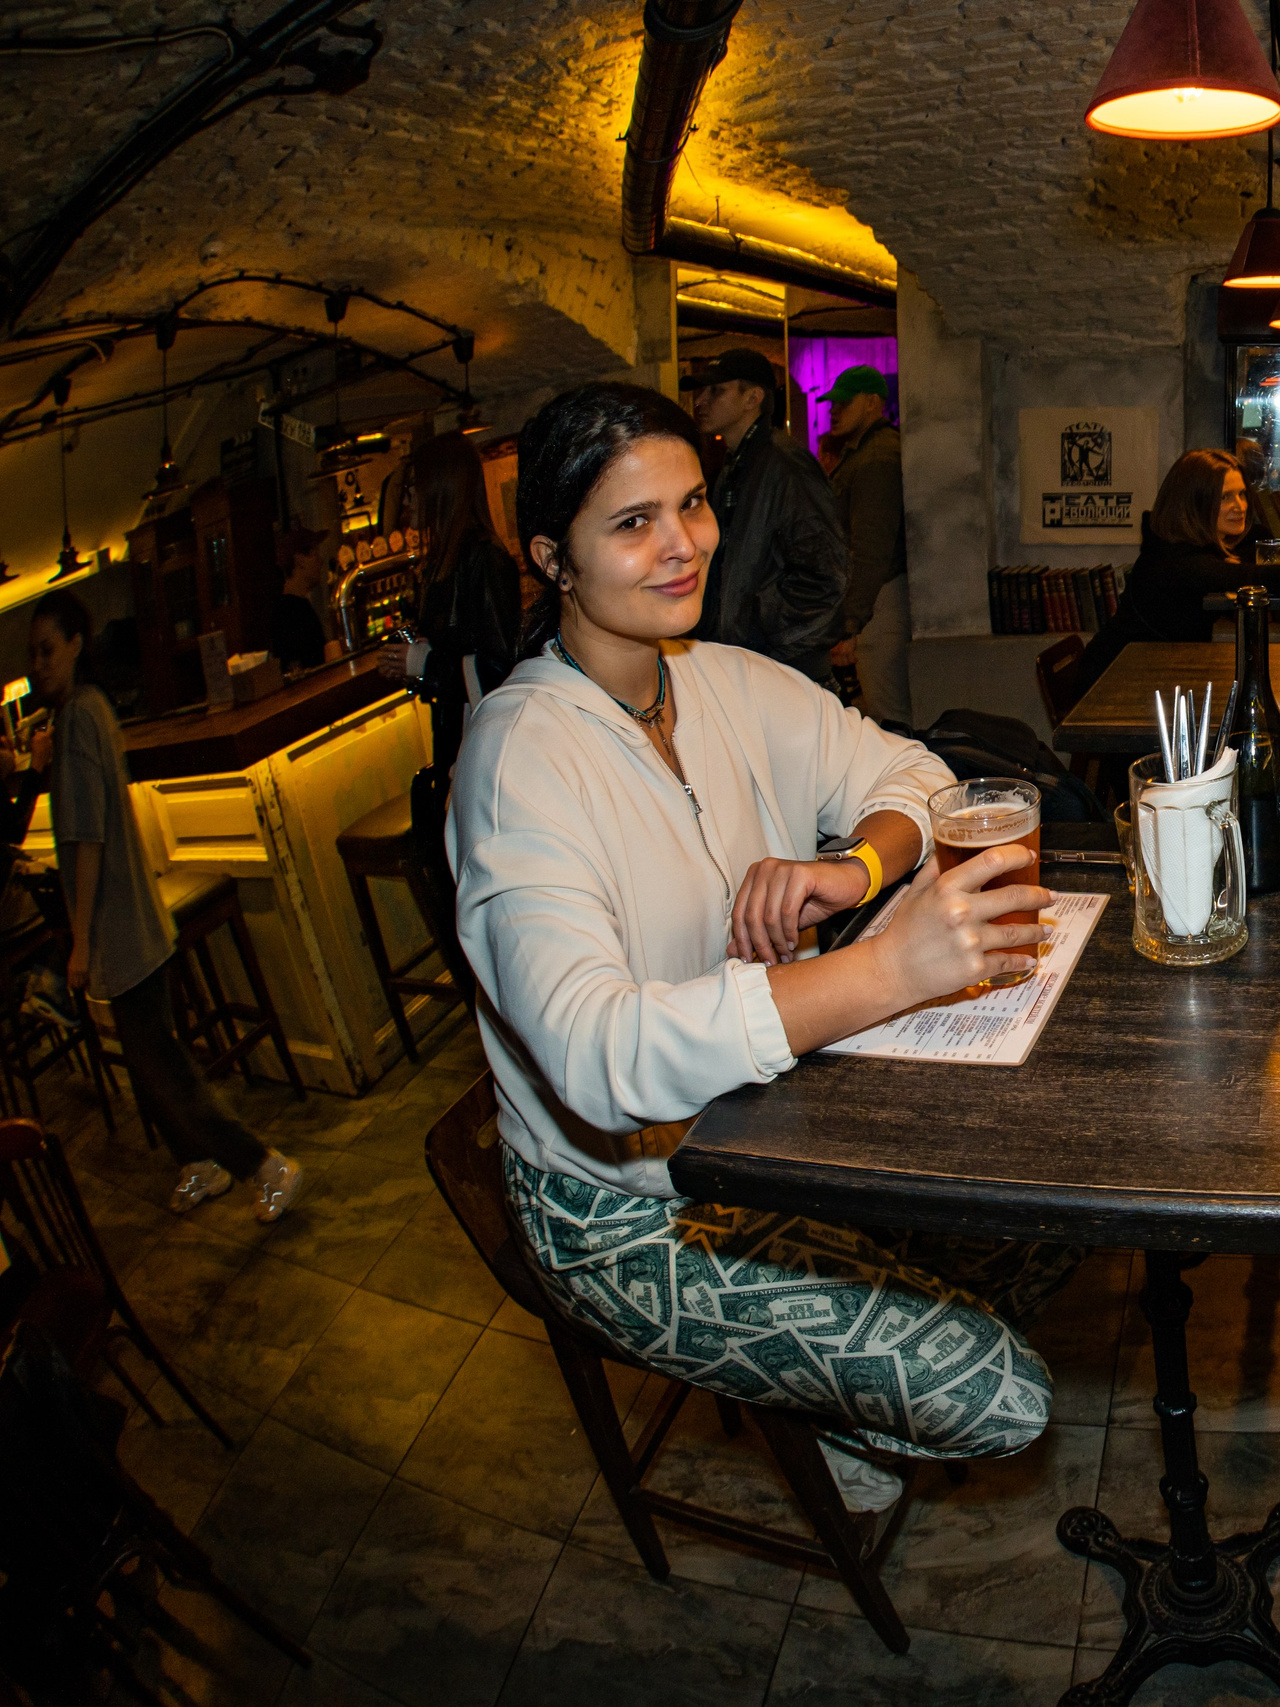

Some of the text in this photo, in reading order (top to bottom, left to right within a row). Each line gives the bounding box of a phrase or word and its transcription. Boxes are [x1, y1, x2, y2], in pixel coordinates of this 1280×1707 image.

[1043, 495, 1131, 506] ТЕАТР
[788, 1303, 814, 1313] ONE
[935, 1332, 955, 1350] ONE
